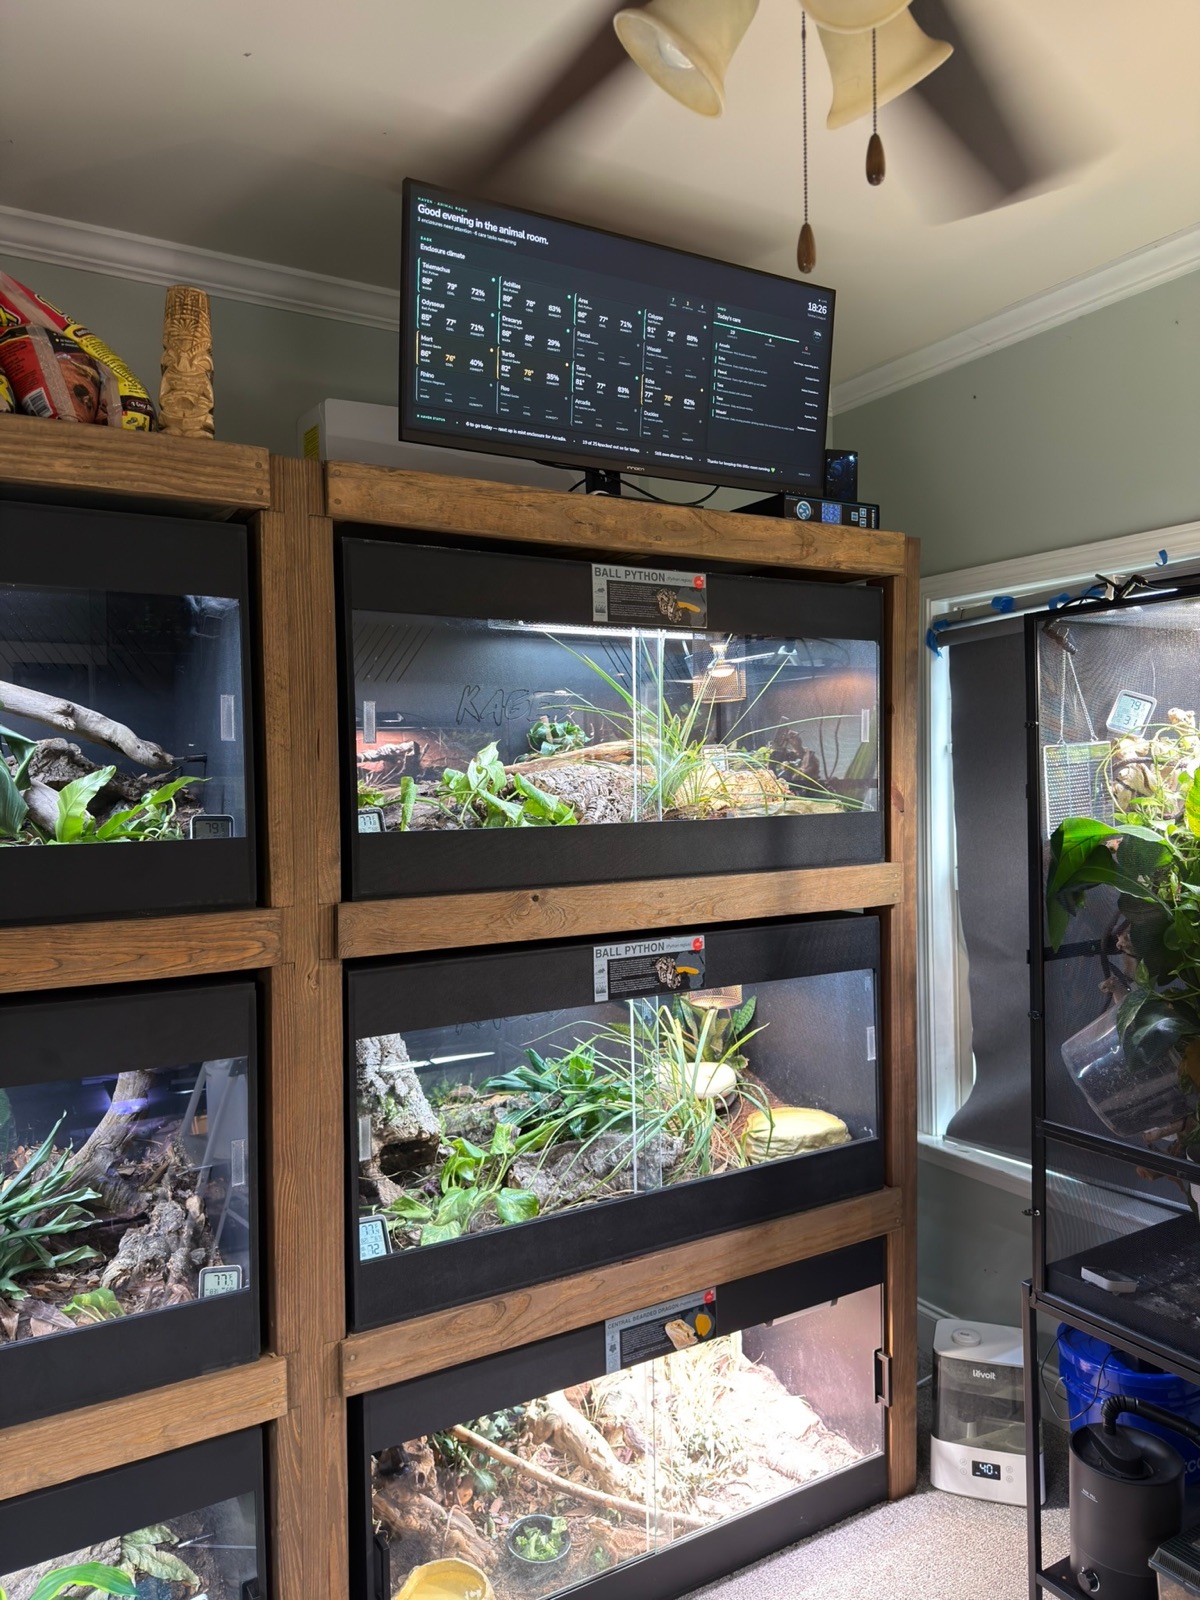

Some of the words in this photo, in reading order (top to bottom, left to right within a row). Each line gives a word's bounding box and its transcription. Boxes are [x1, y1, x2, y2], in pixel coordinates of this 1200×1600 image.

[418, 203, 441, 218] Good
[442, 210, 474, 228] evening
[476, 218, 483, 228] in
[484, 220, 498, 232] the
[499, 224, 526, 239] animal
[527, 233, 549, 245] room.
[421, 218, 443, 227] enclosures
[454, 226, 472, 234] attention
[498, 237, 517, 246] remaining
[420, 243, 445, 255] Enclosure
[447, 249, 465, 260] climate
[422, 262, 450, 274] Telemachus
[503, 281, 521, 289] Achilles
[471, 287, 485, 297] 72%
[422, 299, 445, 309] Odysseus
[549, 304, 561, 313] 83%
[808, 301, 827, 315] 18:26
[503, 316, 522, 325] Dracarys
[599, 316, 608, 324] 77°
[648, 313, 663, 322] Calypso
[717, 313, 732, 322] Today's
[446, 318, 456, 327] 77°
[620, 320, 632, 329] 71%
[471, 323, 484, 332] 71%
[421, 335, 433, 343] Mort
[577, 331, 590, 339] Pascal
[548, 339, 560, 347] 29%
[502, 350, 515, 358] Turtle
[470, 359, 484, 368] 40%
[421, 371, 434, 379] Rhino
[547, 373, 559, 381] 35%
[618, 386, 629, 394] 83%
[645, 391, 653, 399] 77°
[594, 567, 621, 578] BALL
[624, 569, 666, 582] PYTHON
[595, 946, 622, 958] BALL
[625, 942, 665, 955] PYTHON
[607, 1319, 631, 1330] CENTRAL
[632, 1309, 658, 1321] BEARDED
[658, 1303, 680, 1314] DRAGON
